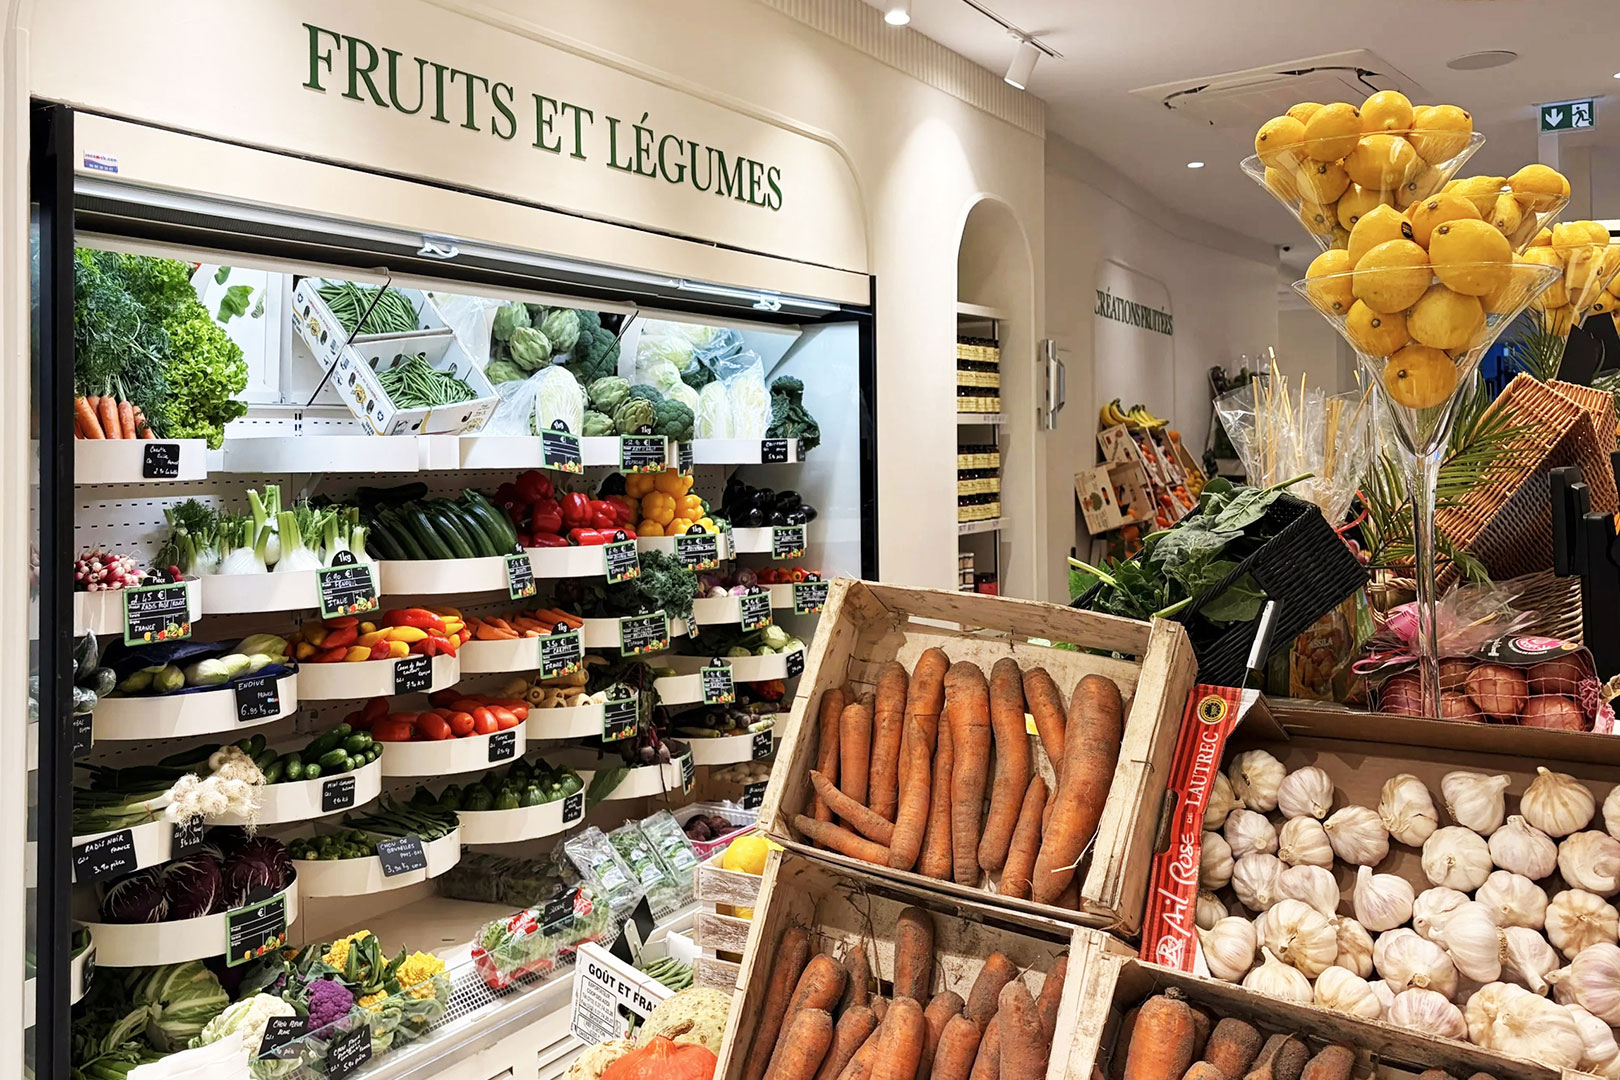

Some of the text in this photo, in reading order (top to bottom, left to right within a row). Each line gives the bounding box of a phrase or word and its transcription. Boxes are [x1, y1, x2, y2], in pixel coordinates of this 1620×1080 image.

[302, 22, 783, 211] FRUITS ET LÉGUMES
[640, 425, 652, 435] 1kg
[338, 551, 352, 563] 1kg
[157, 590, 165, 600] €
[134, 623, 156, 633] FRANCE
[557, 622, 567, 633] 1kg
[1184, 731, 1219, 807] LAUTREC
[1158, 887, 1192, 938] Ail
[588, 963, 657, 1013] GOÛT ET FRA
